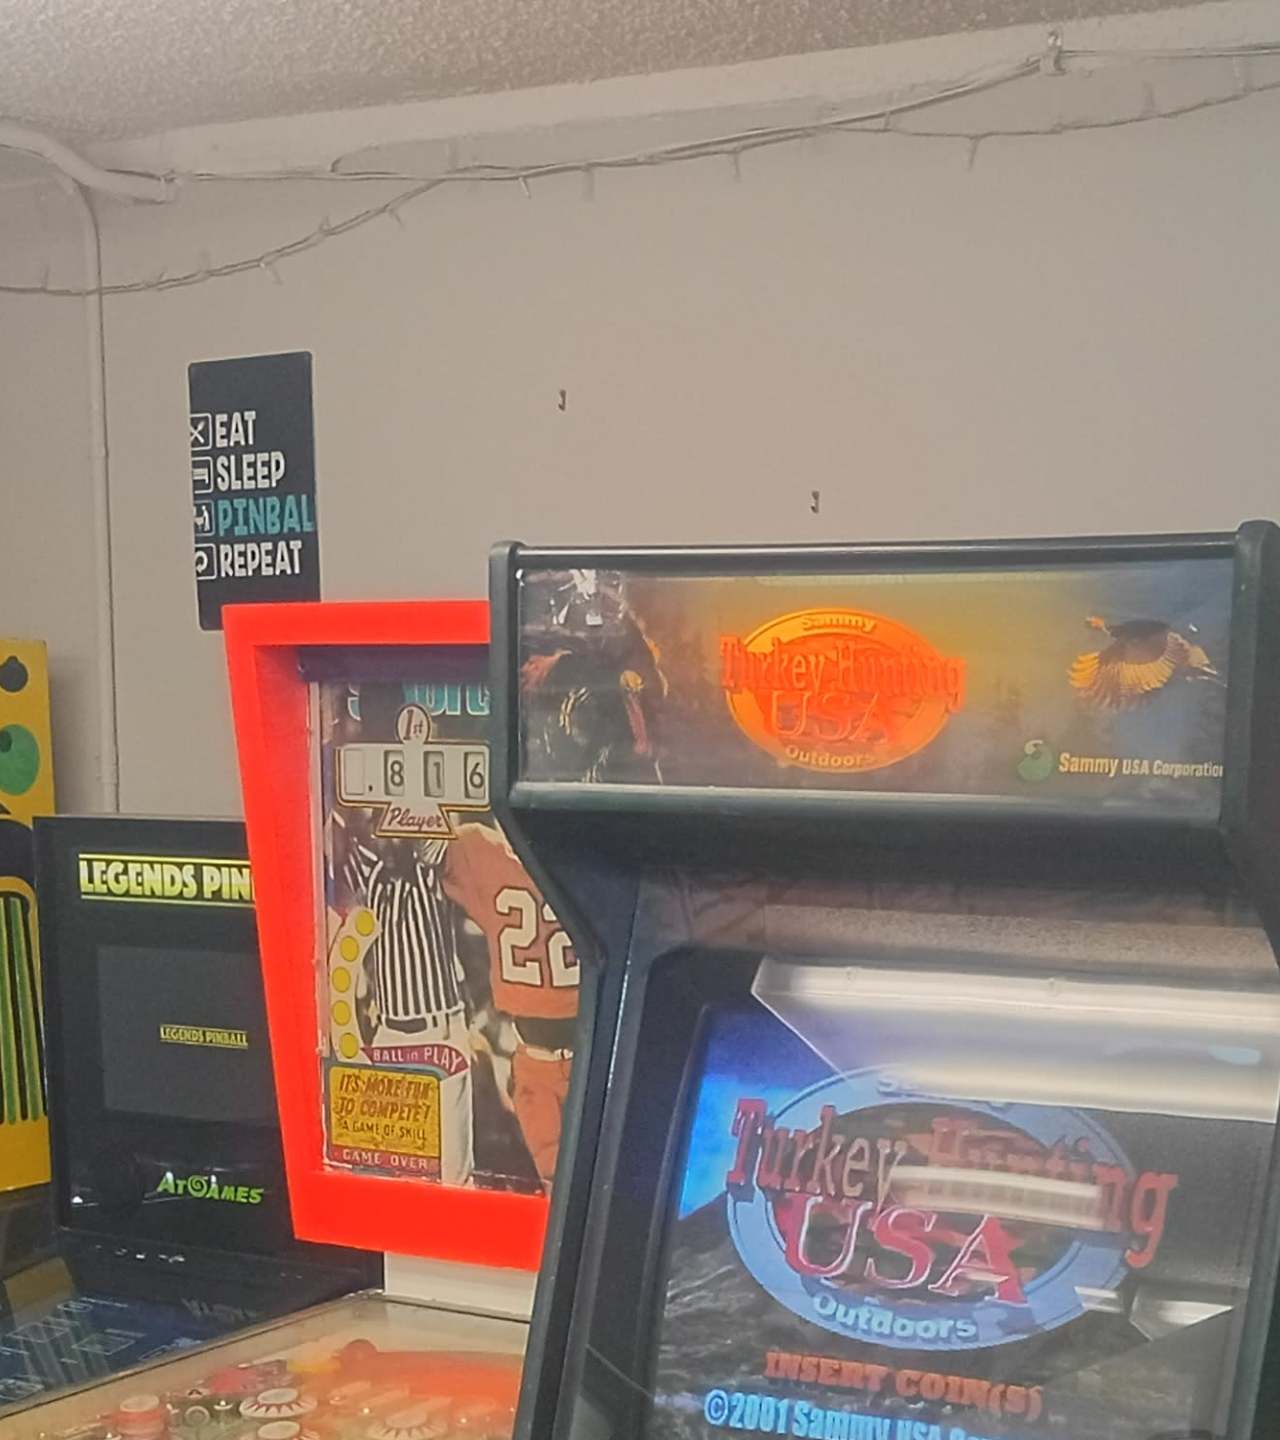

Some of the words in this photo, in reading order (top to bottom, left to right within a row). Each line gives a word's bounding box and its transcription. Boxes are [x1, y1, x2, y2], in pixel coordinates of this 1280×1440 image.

[215, 410, 256, 448] EAT
[216, 451, 285, 491] SLEEP
[218, 494, 315, 537] PINBAL
[220, 540, 302, 578] REPEAT
[802, 613, 877, 633] Sammy
[720, 635, 824, 693] Turkey
[833, 638, 967, 713] Hunting
[404, 708, 424, 741] 1st
[772, 689, 888, 743] USA
[1058, 752, 1119, 777] Sammy
[1122, 759, 1149, 776] USA
[388, 807, 443, 832] Player
[79, 861, 197, 899] LEGENDS
[203, 866, 257, 901] PIN
[160, 1027, 203, 1042] LEGENDS
[206, 1031, 248, 1047] PINBALL
[373, 1049, 404, 1062] BALL
[424, 1047, 463, 1073] PLAY
[337, 1097, 357, 1115] TO
[365, 1076, 402, 1098] MORE
[341, 1121, 349, 1131] A
[352, 1122, 380, 1136] GAME
[384, 1125, 396, 1137] OF
[399, 1127, 427, 1141] SKILL
[342, 1149, 382, 1165] GAME
[390, 1153, 428, 1169] OVER
[726, 1098, 908, 1208] Turkey
[785, 1194, 1025, 1306] USA
[813, 1295, 977, 1340] Outdoors
[763, 1350, 888, 1392] INSERT
